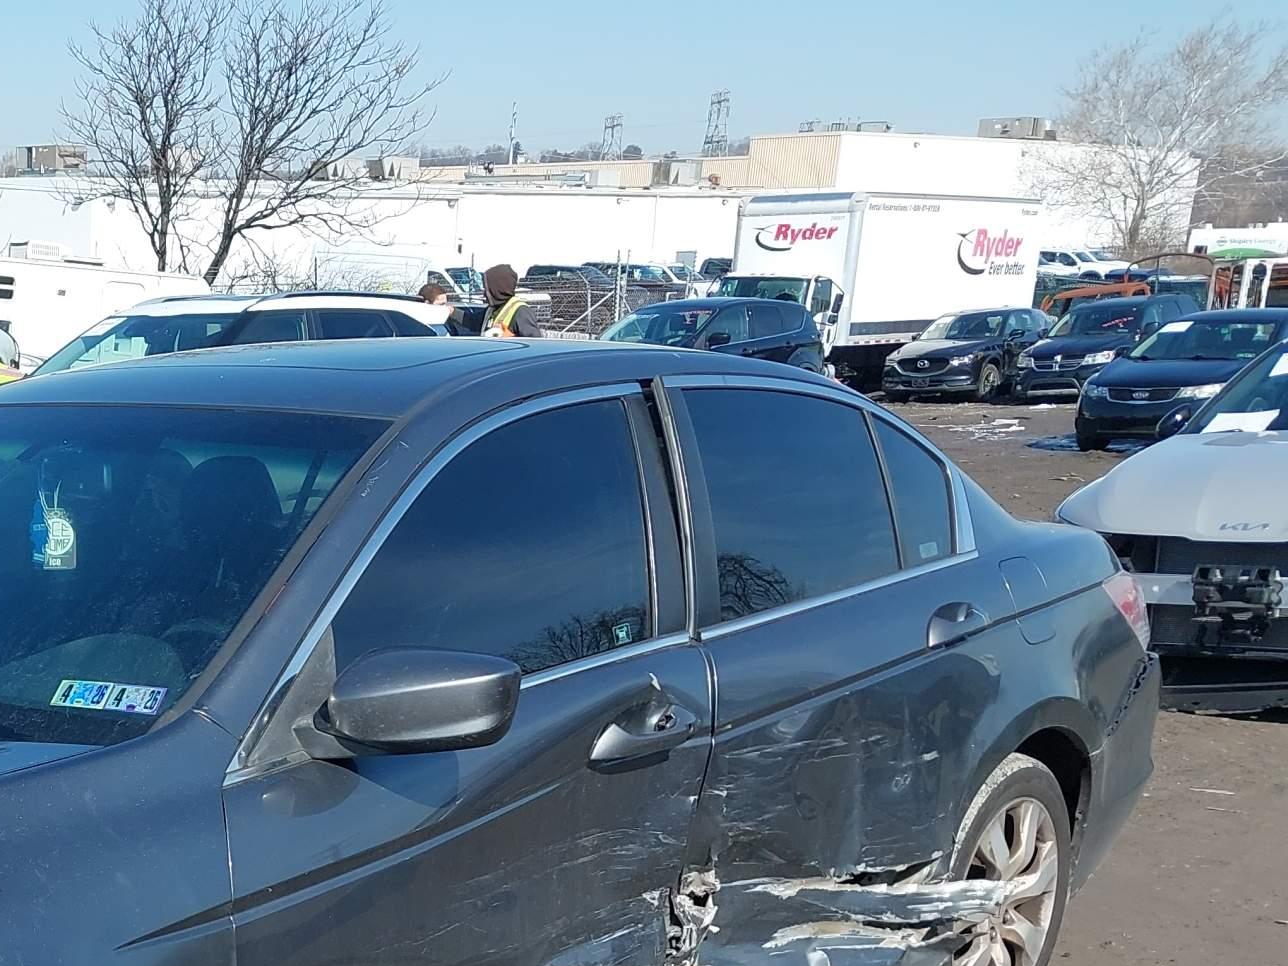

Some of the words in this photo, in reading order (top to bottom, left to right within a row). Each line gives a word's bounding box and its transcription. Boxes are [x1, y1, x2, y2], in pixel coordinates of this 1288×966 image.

[773, 222, 839, 245] Ryder
[971, 228, 1023, 264] Ryder
[988, 261, 1004, 275] Ever
[61, 684, 75, 703] 4
[112, 687, 127, 708] 4
